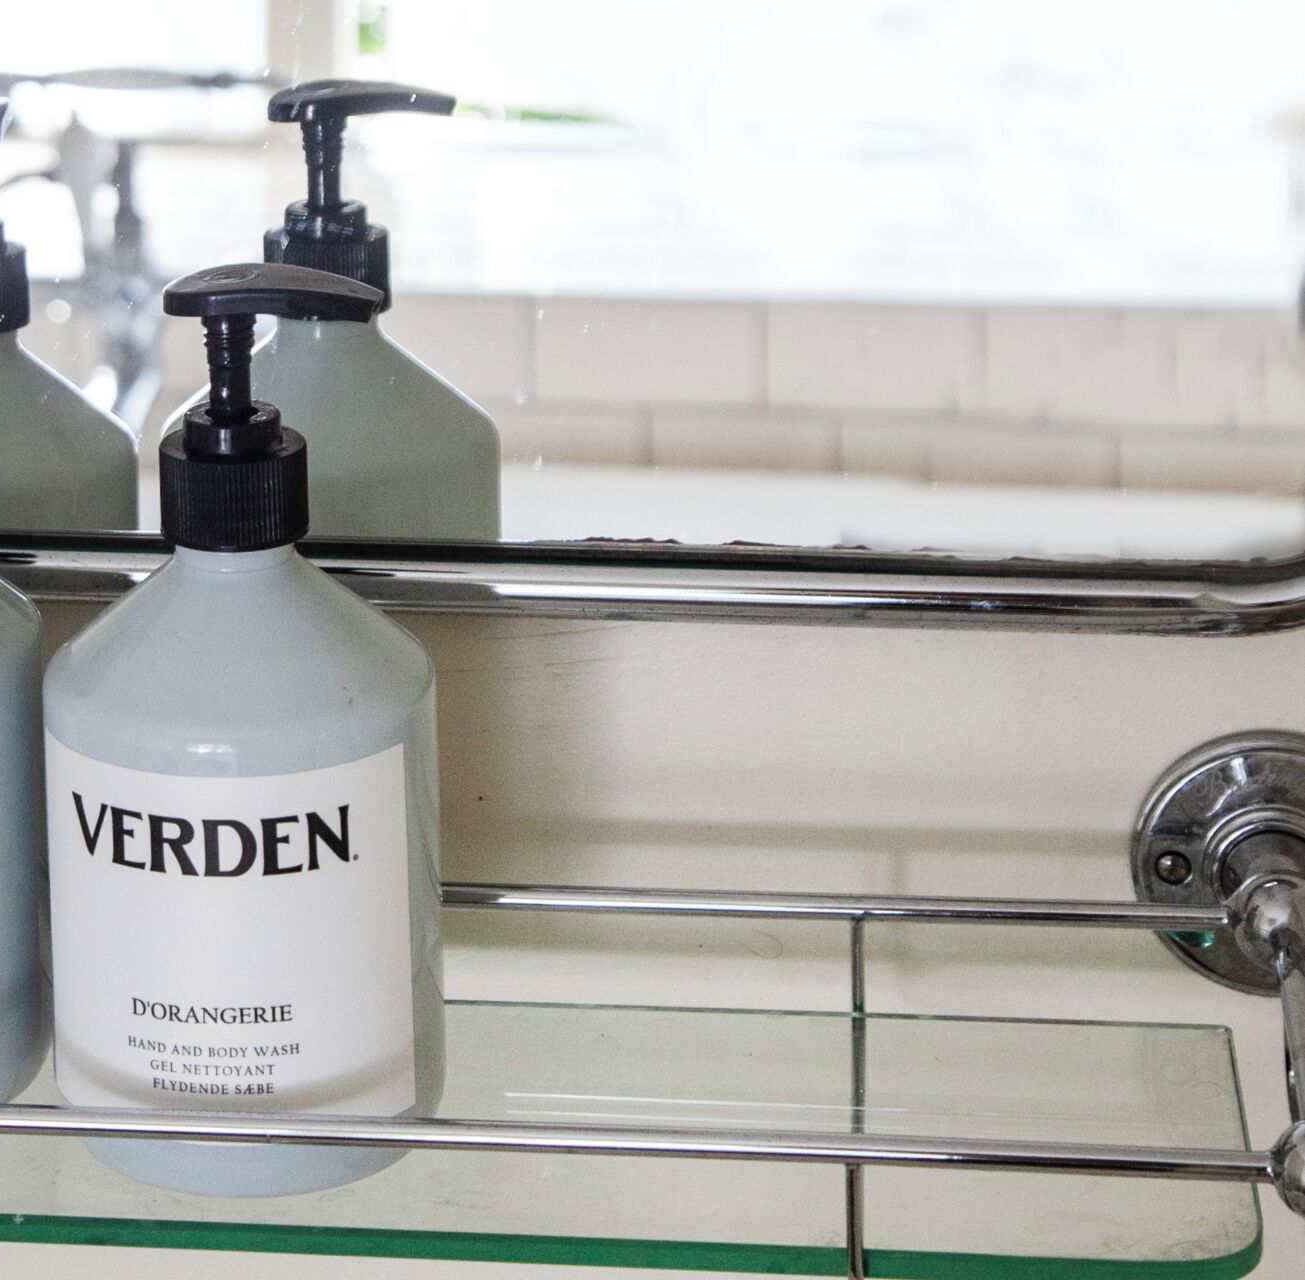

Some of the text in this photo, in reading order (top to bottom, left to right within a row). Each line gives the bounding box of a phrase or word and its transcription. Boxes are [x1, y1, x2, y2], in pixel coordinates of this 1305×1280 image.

[132, 997, 293, 1024] D'ORANGERIE
[128, 1035, 300, 1058] HAND AND BODY WASH
[150, 1059, 276, 1076] GEL NETTOYANT
[153, 1077, 274, 1095] FLYDENDE SÆBE
